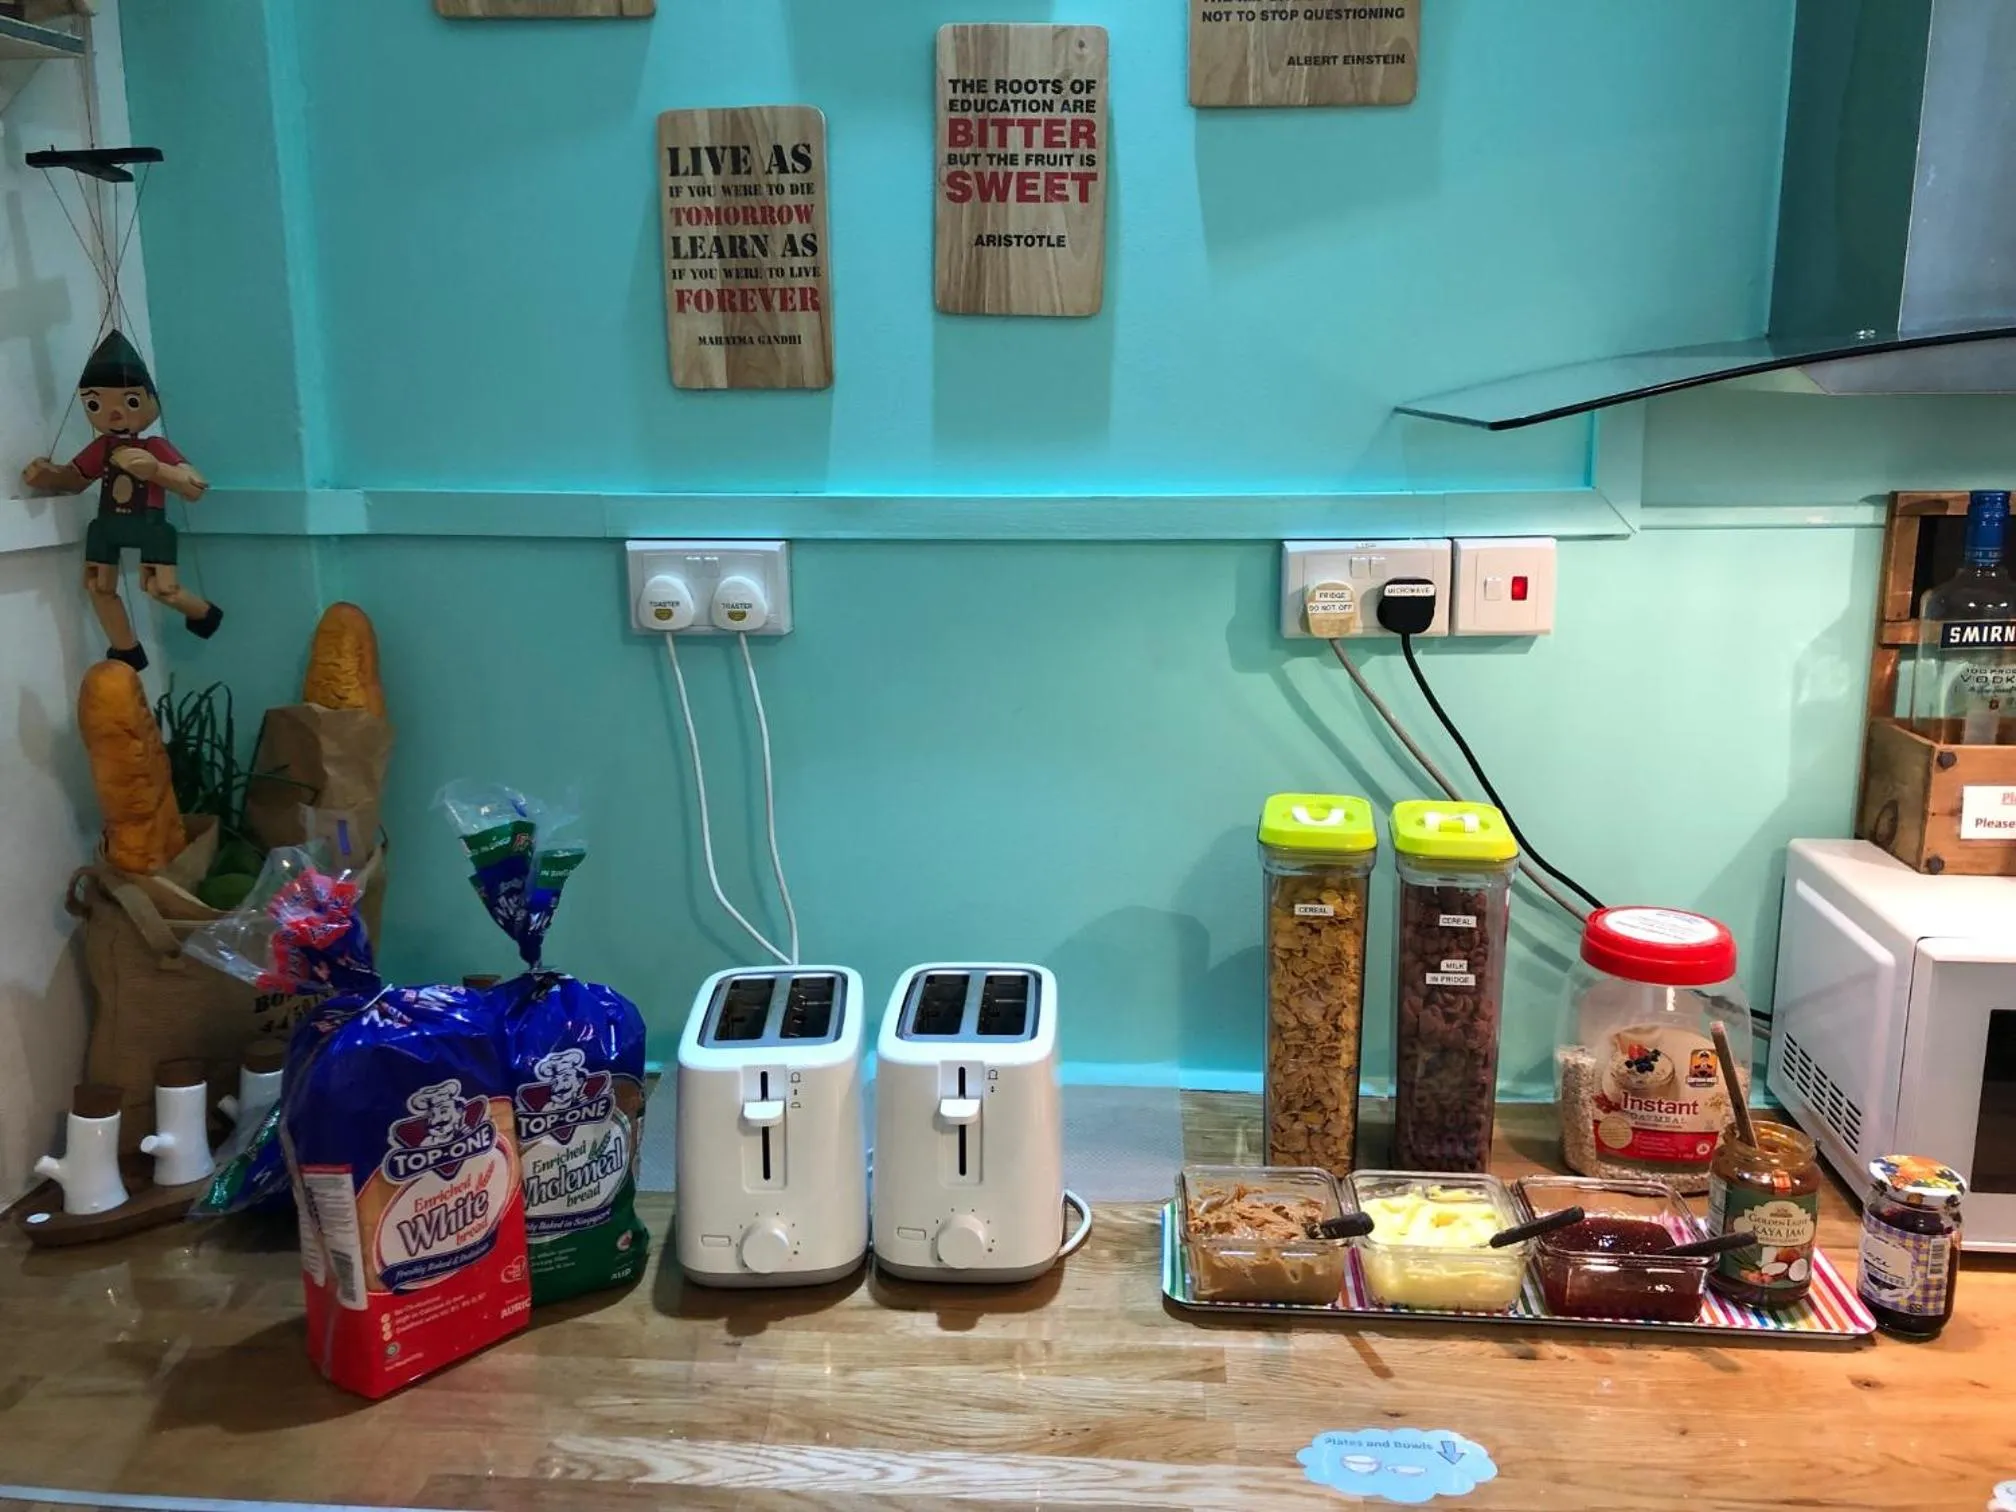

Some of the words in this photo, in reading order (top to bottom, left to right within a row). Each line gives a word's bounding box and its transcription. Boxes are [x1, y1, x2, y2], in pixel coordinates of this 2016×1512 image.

[1202, 11, 1232, 22] NOT
[1237, 10, 1255, 22] TO
[1260, 9, 1299, 21] STOP
[1303, 8, 1405, 21] QUESTIONING
[1287, 55, 1338, 66] ALBERT
[1343, 54, 1405, 66] EINSTEIN
[948, 79, 988, 94] THE
[995, 79, 1064, 94] ROOTS
[1070, 79, 1097, 94] OF
[948, 99, 1054, 113] EDUCATION
[1060, 99, 1096, 113] ARE
[948, 118, 1096, 149] BITTER
[667, 146, 752, 177] LIVE
[765, 143, 813, 175] AS
[947, 153, 982, 166] BUT
[986, 153, 1019, 166] THE
[1025, 153, 1074, 166] FRUIT
[1080, 153, 1096, 166] IS
[669, 185, 683, 198] IF
[687, 184, 716, 197] YOU
[721, 184, 763, 197] WERE
[765, 183, 785, 196] TO
[789, 182, 815, 195] DIE
[946, 171, 1098, 204] SWEET
[670, 203, 815, 227] TOMORROW
[671, 234, 769, 260] LEARN
[781, 232, 818, 258] AS
[974, 235, 1066, 248] ARISTOTLE
[672, 268, 686, 280] IF
[690, 268, 717, 280] YOU
[723, 267, 763, 279] WERE
[768, 267, 785, 278] TO
[789, 266, 822, 278] LIVE
[675, 286, 820, 314] FOREVER
[699, 335, 754, 346] MAHATMA
[757, 334, 802, 345] GANDHI
[649, 600, 680, 608] TOASTER
[1949, 625, 2016, 643] SMIRN
[2002, 791, 2016, 803] Pl
[1975, 816, 2016, 829] Please
[1299, 906, 1328, 914] CEREAL
[1442, 917, 1472, 925] CEREAL
[1622, 1091, 1699, 1115] Instant
[518, 1099, 607, 1138] TOP-ONE
[394, 1126, 491, 1176] TOP-ONE
[532, 1140, 587, 1175] Enriched
[414, 1173, 472, 1213] Enriched
[566, 1181, 601, 1208] bread
[397, 1189, 489, 1257] White
[1753, 1224, 1783, 1237] KAYA
[456, 1217, 488, 1246] bread
[1366, 1440, 1390, 1449] and
